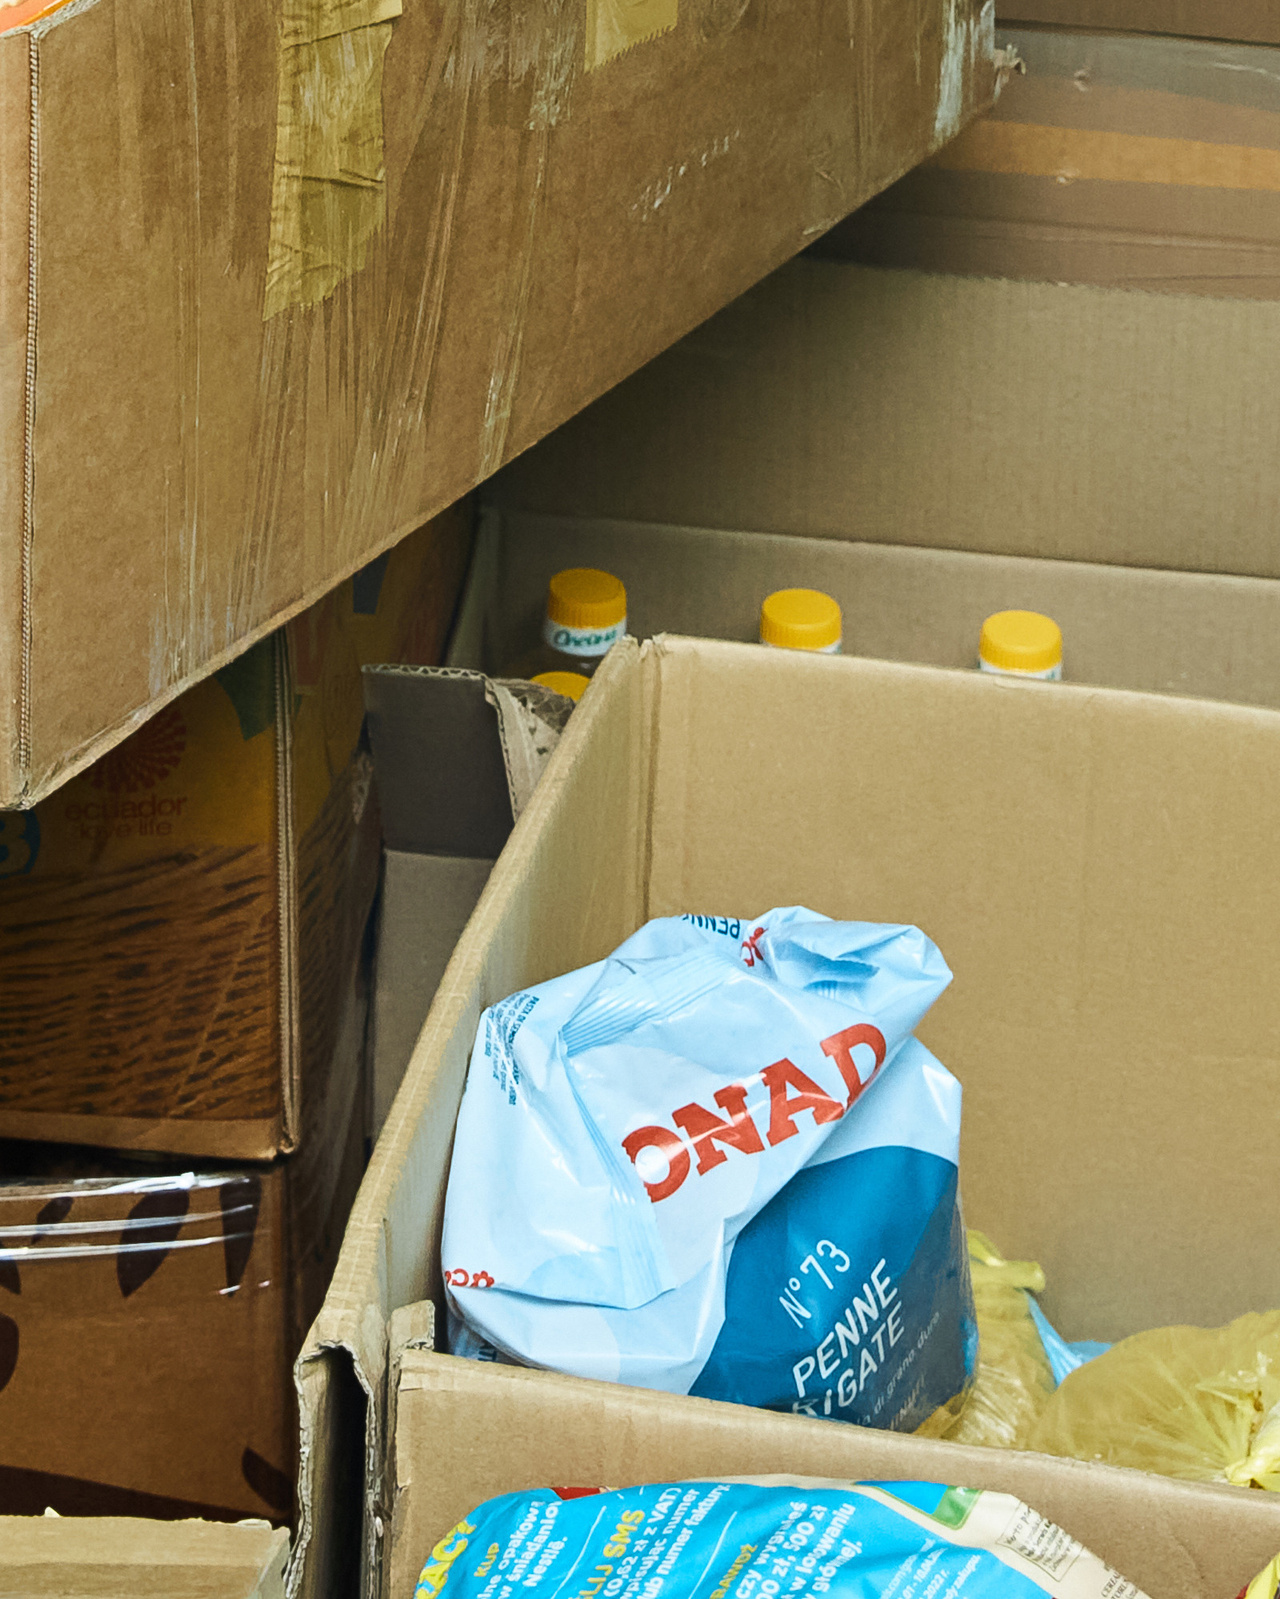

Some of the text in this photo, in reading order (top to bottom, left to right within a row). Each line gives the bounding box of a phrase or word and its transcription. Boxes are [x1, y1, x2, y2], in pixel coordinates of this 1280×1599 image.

[64, 792, 188, 821] ecuador
[138, 818, 173, 838] life
[799, 1239, 851, 1290] 73
[792, 1258, 898, 1398] PENNE
[886, 1349, 916, 1395] grano
[917, 1311, 941, 1350] duro
[603, 1508, 646, 1559] SMS
[662, 1488, 701, 1536] numer
[781, 1520, 817, 1554] 500
[810, 1504, 829, 1523] zł
[473, 1542, 500, 1578] KUP
[523, 1535, 568, 1588] Nestlé.
[655, 1525, 694, 1577] numer
[802, 1501, 858, 1576] losowaniu
[736, 1566, 763, 1599] czy
